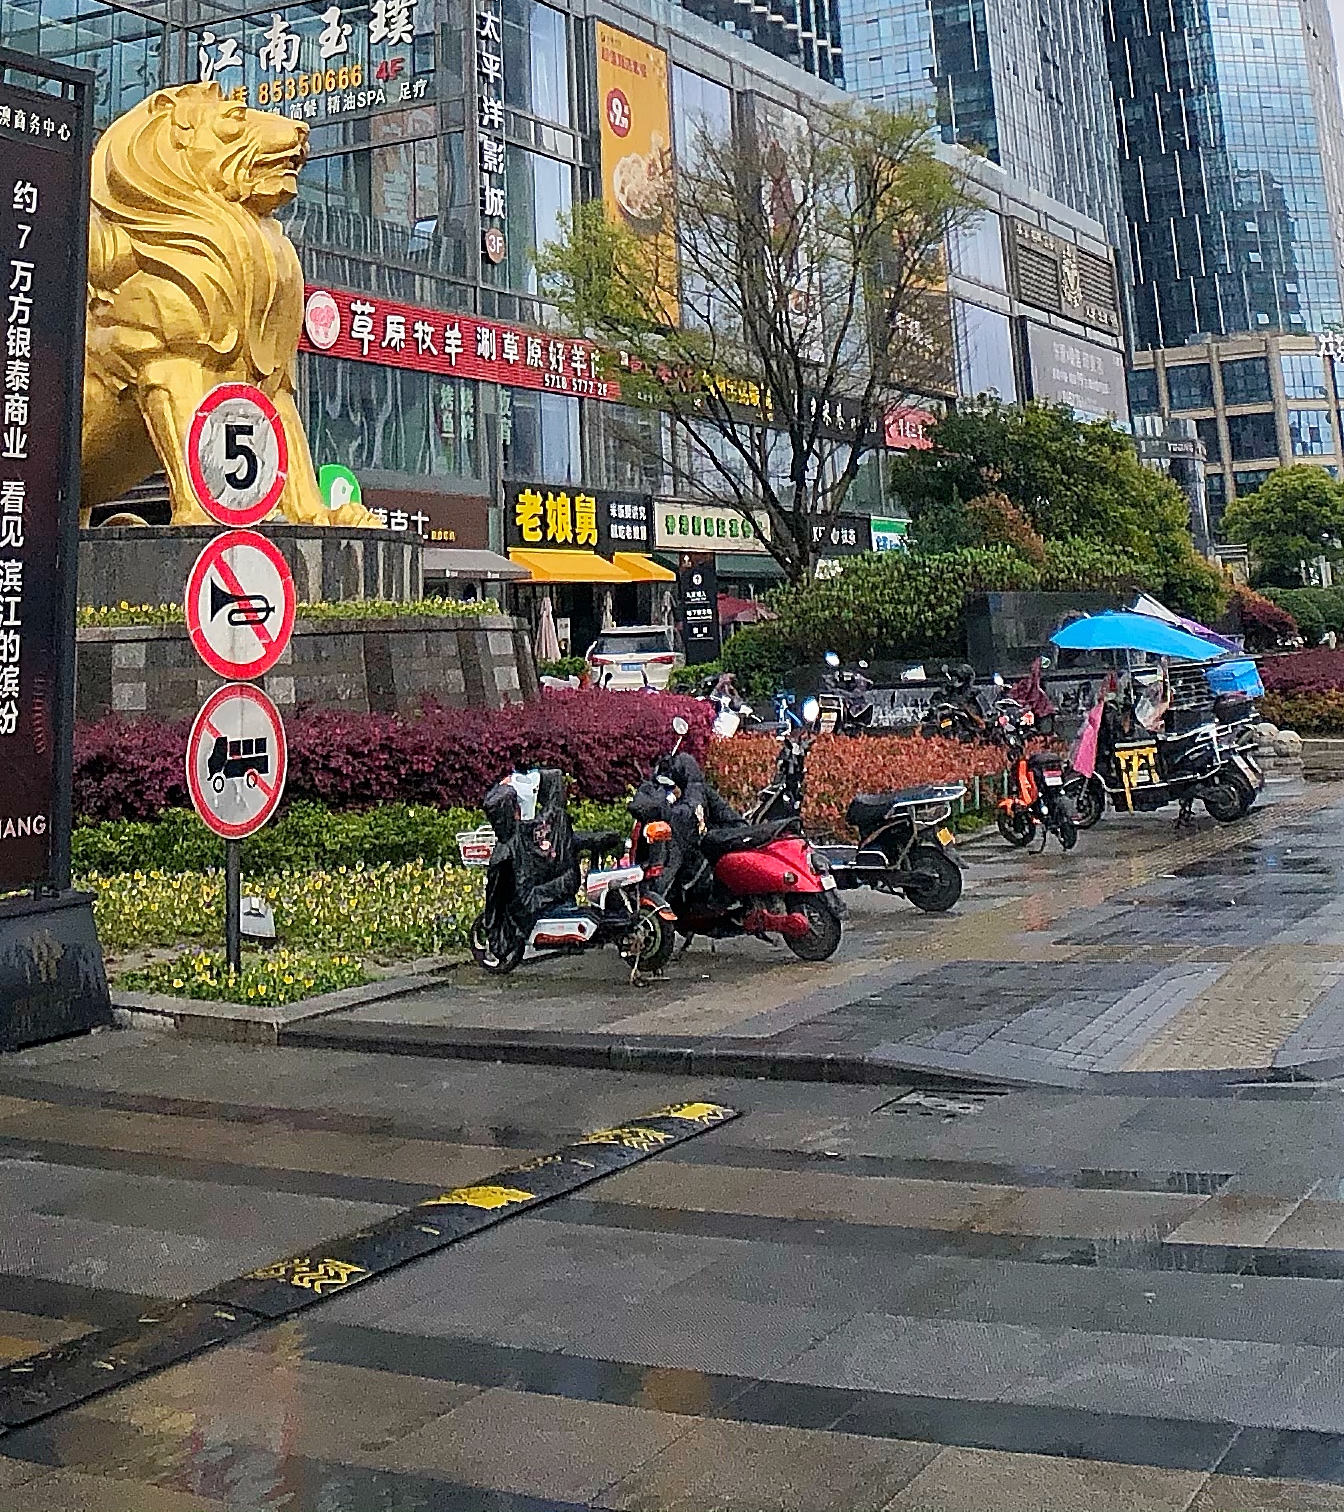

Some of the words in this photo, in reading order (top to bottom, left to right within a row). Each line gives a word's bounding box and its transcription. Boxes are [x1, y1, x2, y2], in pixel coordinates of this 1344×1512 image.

[258, 63, 362, 105] 85350666
[327, 88, 387, 115] 精油SPA
[399, 78, 429, 102] 足疗
[376, 57, 406, 83] 4F
[480, 11, 505, 219] 太平洋影城
[489, 234, 503, 254] 3F
[351, 300, 464, 366] 草原牧羊
[225, 424, 259, 489] 5
[0, 480, 26, 548] 看见
[515, 489, 598, 546] 老娘舅
